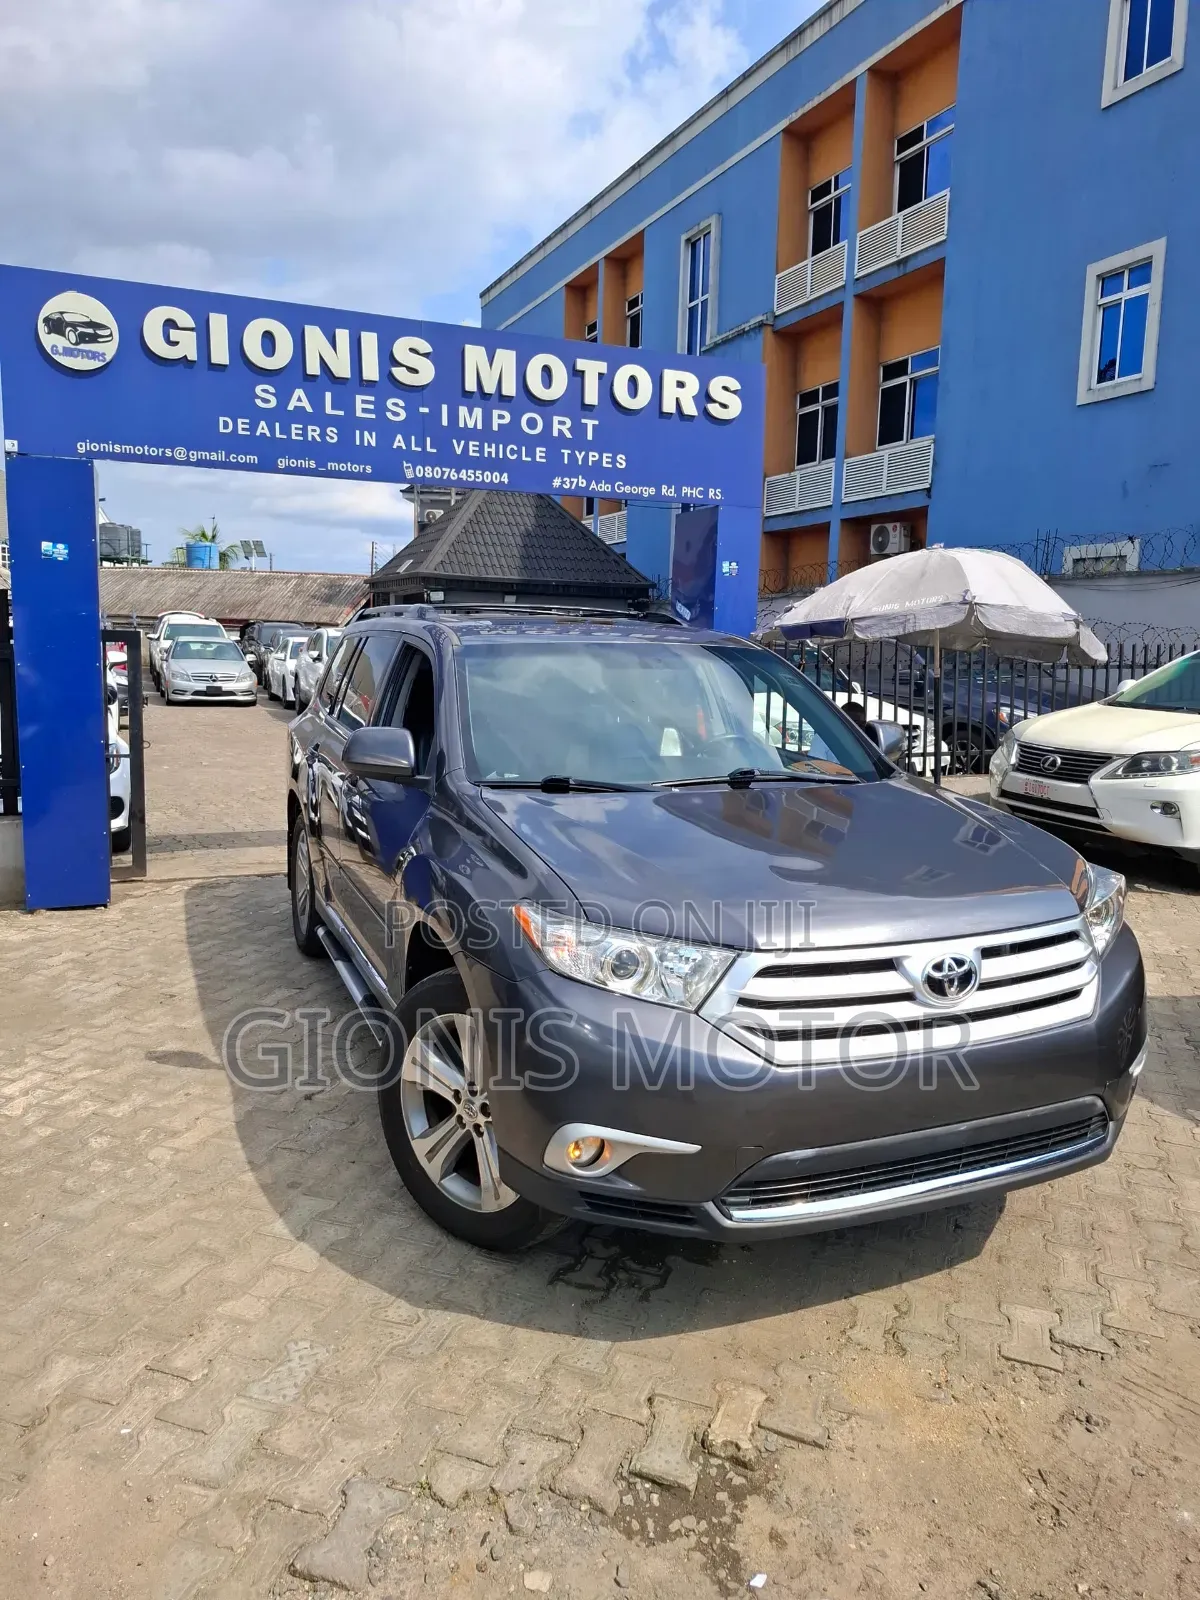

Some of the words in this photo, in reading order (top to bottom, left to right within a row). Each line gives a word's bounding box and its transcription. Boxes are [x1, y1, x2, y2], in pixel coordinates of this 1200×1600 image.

[50, 344, 107, 363] G.MOTORS
[142, 305, 436, 388] GIONIS
[464, 344, 743, 420] MOTORS
[76, 439, 258, 464] gionismotors@gmail.com
[218, 416, 338, 443] DEALERS
[355, 429, 376, 447] IN
[392, 434, 437, 453] ALL
[452, 438, 547, 463] VEHICLE
[560, 449, 627, 470] TYPES
[415, 465, 509, 485] 08076455004
[552, 475, 587, 490] #37b
[588, 480, 612, 492] Ada
[614, 481, 656, 498] George
[661, 484, 677, 498] Rd,
[681, 486, 704, 499] PHC
[708, 488, 725, 500] RS.
